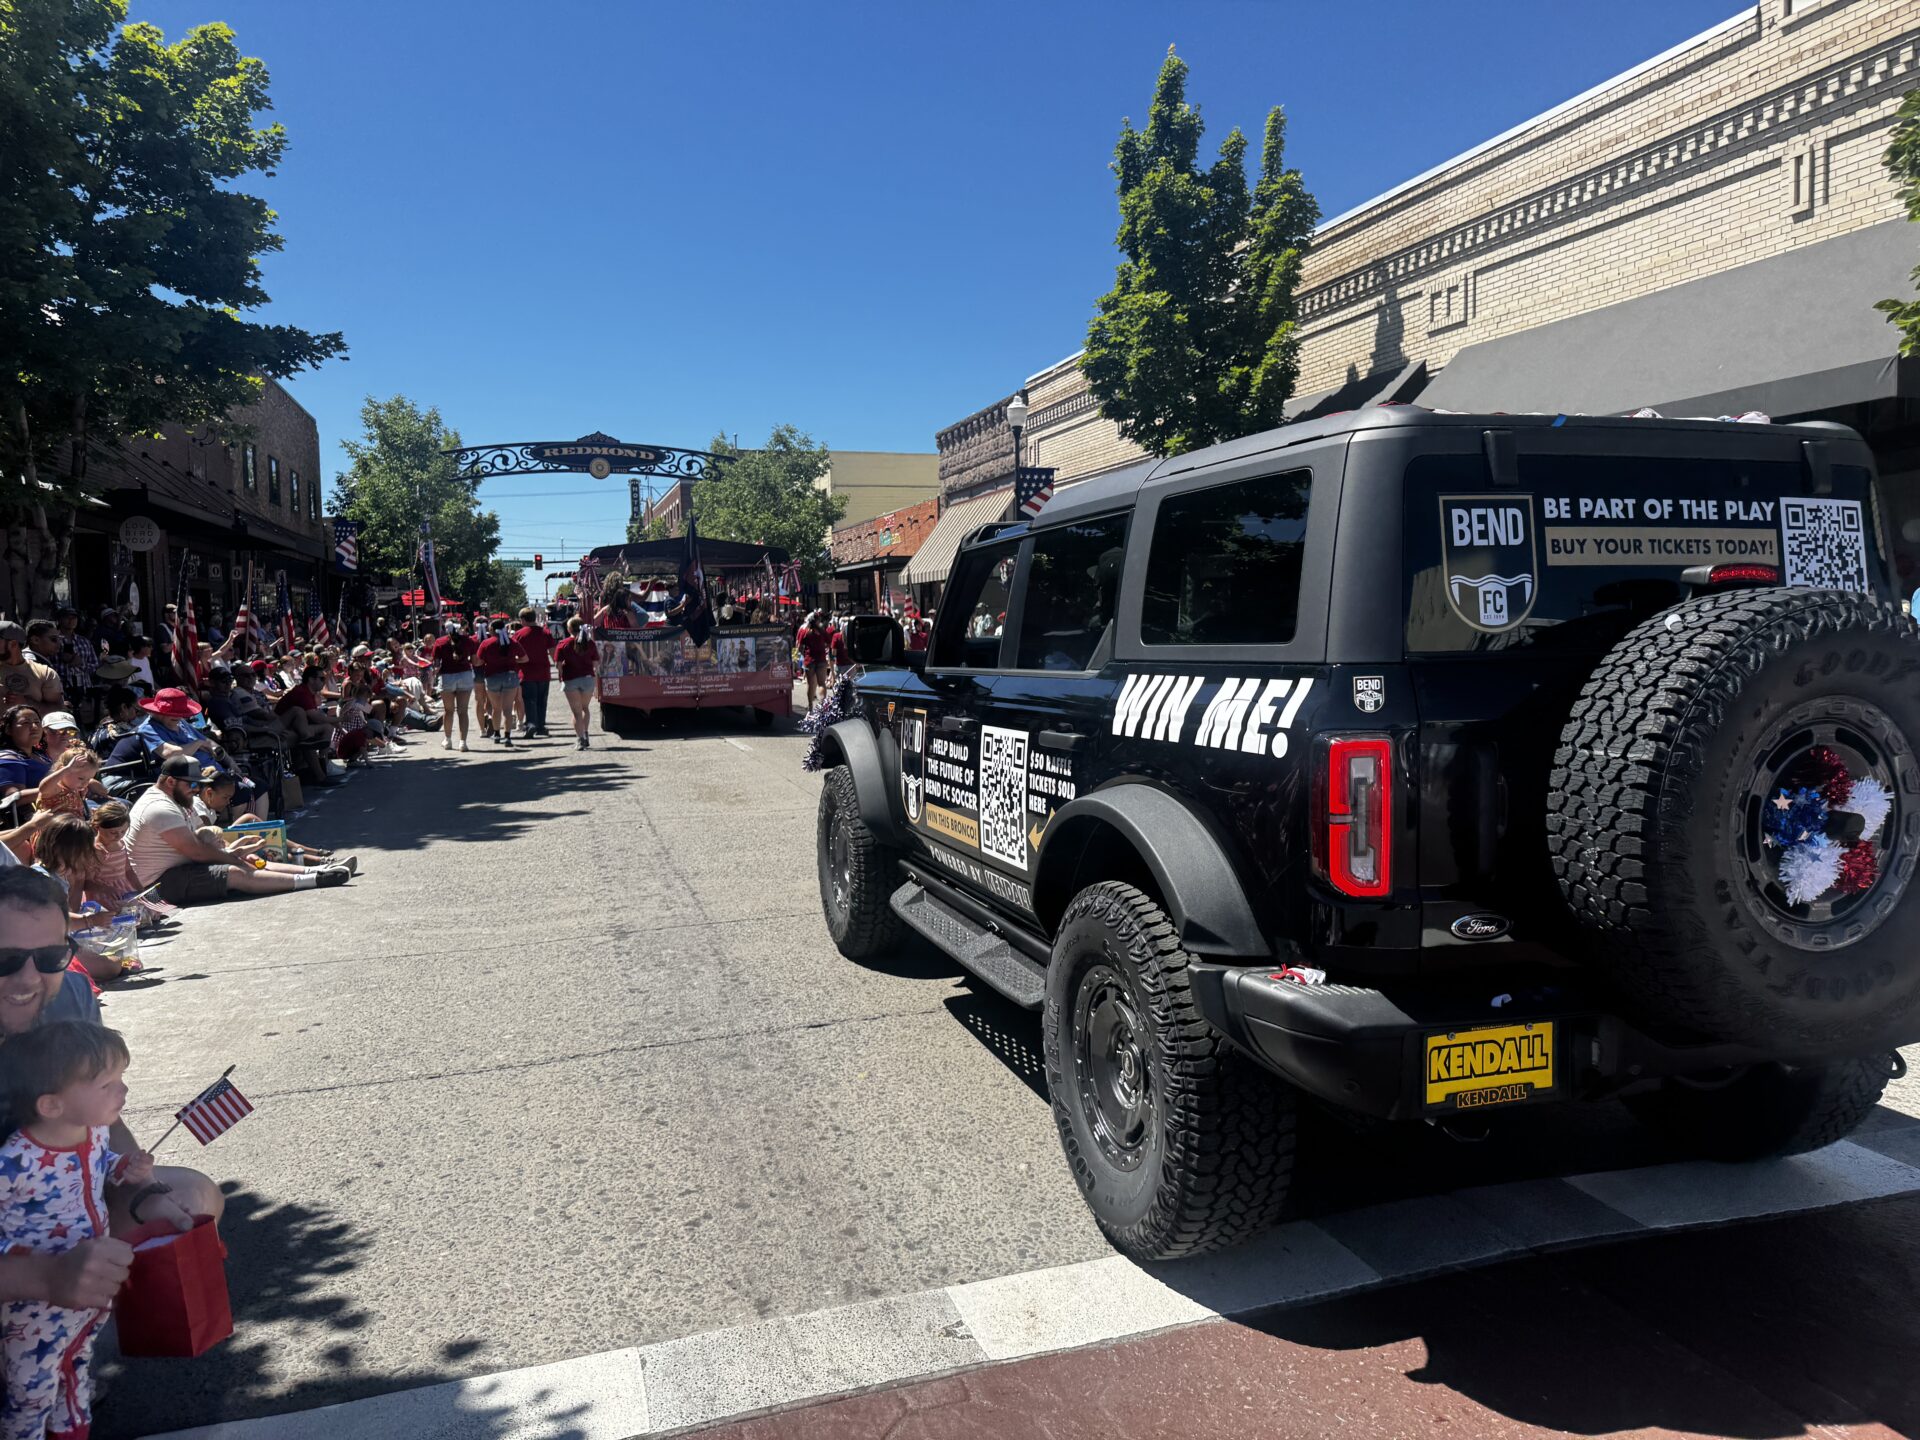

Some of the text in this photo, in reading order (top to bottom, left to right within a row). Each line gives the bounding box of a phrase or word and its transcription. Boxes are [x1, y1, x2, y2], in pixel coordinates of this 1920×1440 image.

[543, 446, 656, 460] REDMOND
[1544, 497, 1775, 522] BE PART OF THE PLAY
[1451, 507, 1524, 547] BEND
[1550, 538, 1774, 556] BUY YOUR TICKETS TODAY!
[1482, 590, 1504, 614] FC
[1357, 679, 1381, 691] BEND
[1112, 674, 1314, 759] WIN ME!
[933, 738, 969, 762] HELP BUILD
[1029, 749, 1073, 777] $50 RAFFLE
[927, 758, 975, 787] THE FUTURE OF
[925, 778, 978, 812] BEND FC SOCCER
[1028, 772, 1076, 801] TICKETS SOLD
[1028, 793, 1047, 815] HERE
[927, 809, 977, 841] WIN THIS BRONCO!
[930, 845, 969, 877] POWERED
[969, 865, 982, 885] BY
[1466, 919, 1499, 934] Ford
[1429, 1034, 1549, 1084] KENDALL
[1457, 1084, 1527, 1108] KENDALL
